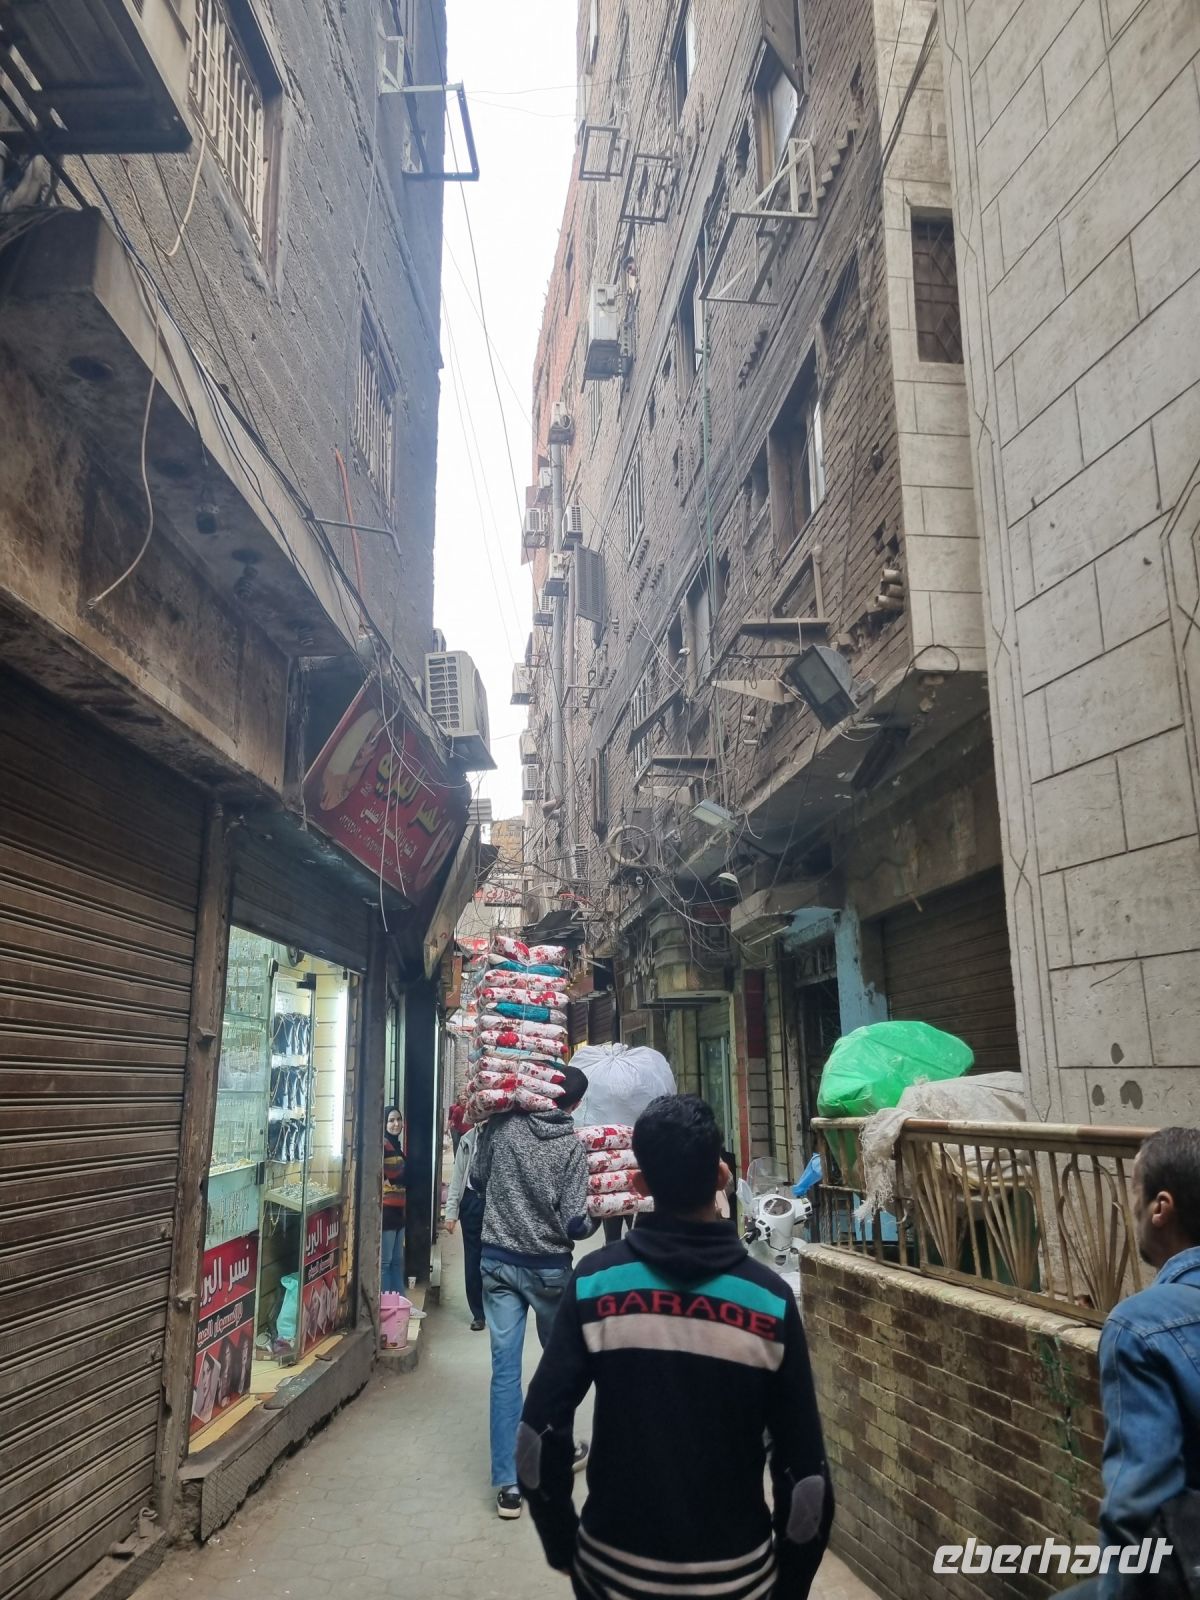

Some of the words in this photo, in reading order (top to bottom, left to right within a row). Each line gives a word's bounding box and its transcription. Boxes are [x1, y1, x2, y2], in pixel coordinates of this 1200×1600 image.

[305, 1219, 323, 1257] البري
[326, 1211, 339, 1248] نسر
[228, 1243, 250, 1292] نسر
[596, 1290, 777, 1339] GARAGE
